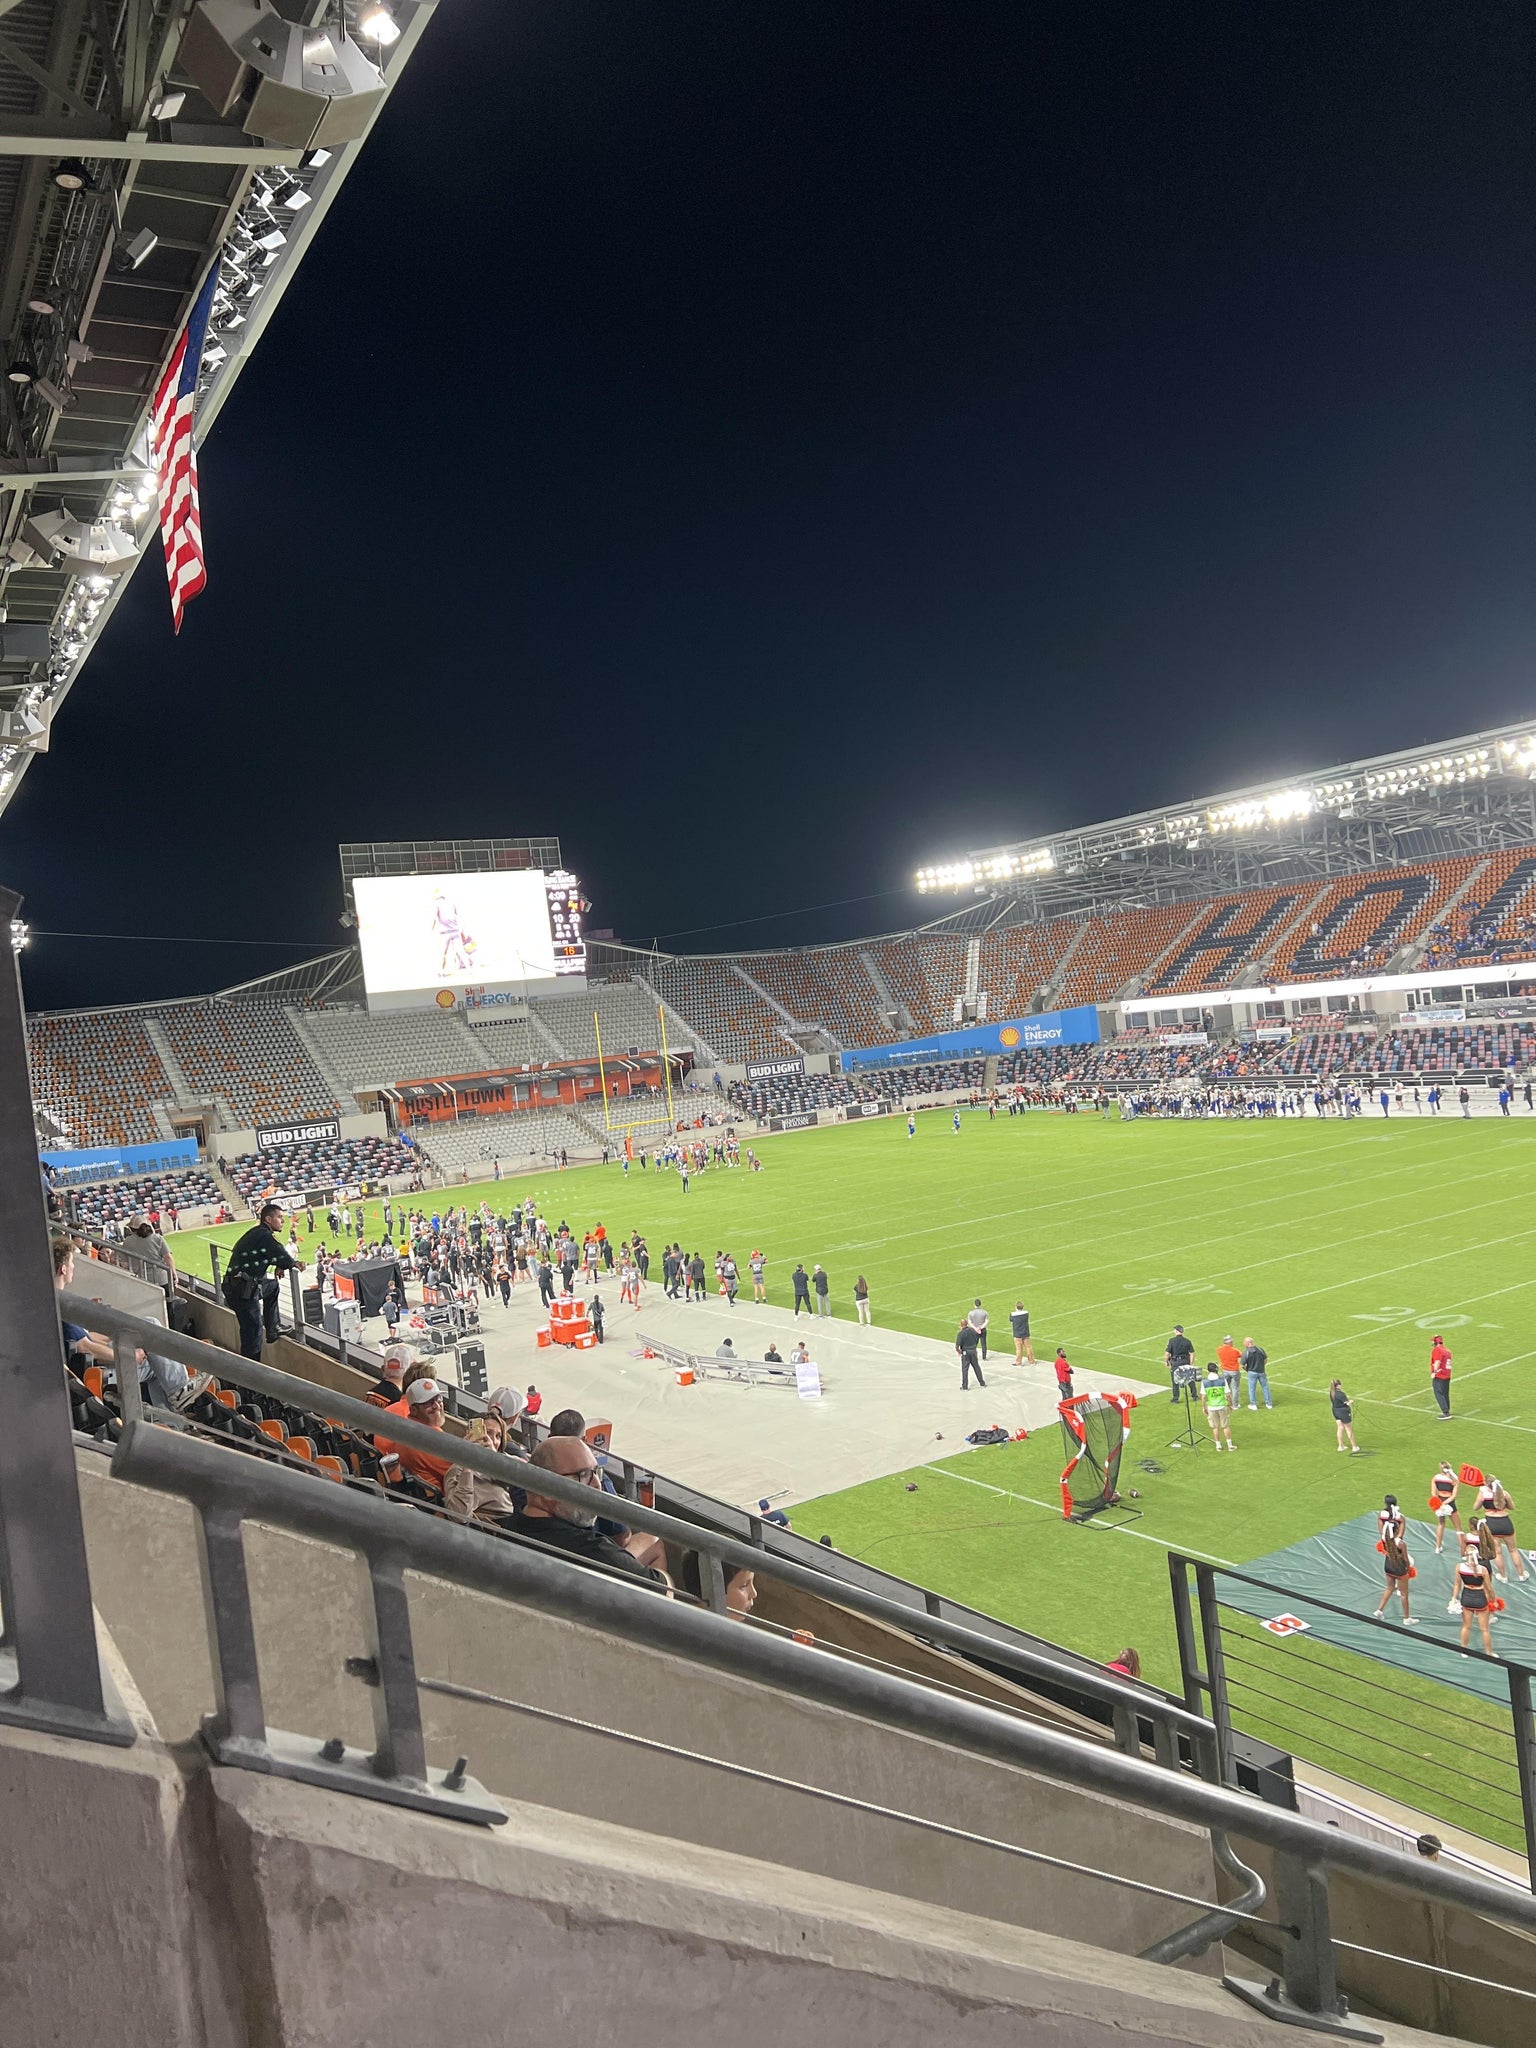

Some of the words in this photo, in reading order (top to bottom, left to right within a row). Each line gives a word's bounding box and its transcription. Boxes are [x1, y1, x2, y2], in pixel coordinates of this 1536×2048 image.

[553, 914, 563, 923] 10
[569, 914, 580, 923] 20
[563, 946, 575, 955] 16
[465, 986, 485, 996] Shll
[1024, 1024, 1041, 1032] Shell
[1025, 1029, 1062, 1041] ENERGY
[750, 1065, 771, 1078] BUD
[772, 1060, 801, 1075] LIGHT
[464, 1088, 506, 1106] TOWN
[261, 1130, 293, 1146] BUD
[293, 1125, 335, 1141] LIGHT
[1462, 1466, 1475, 1483] 10
